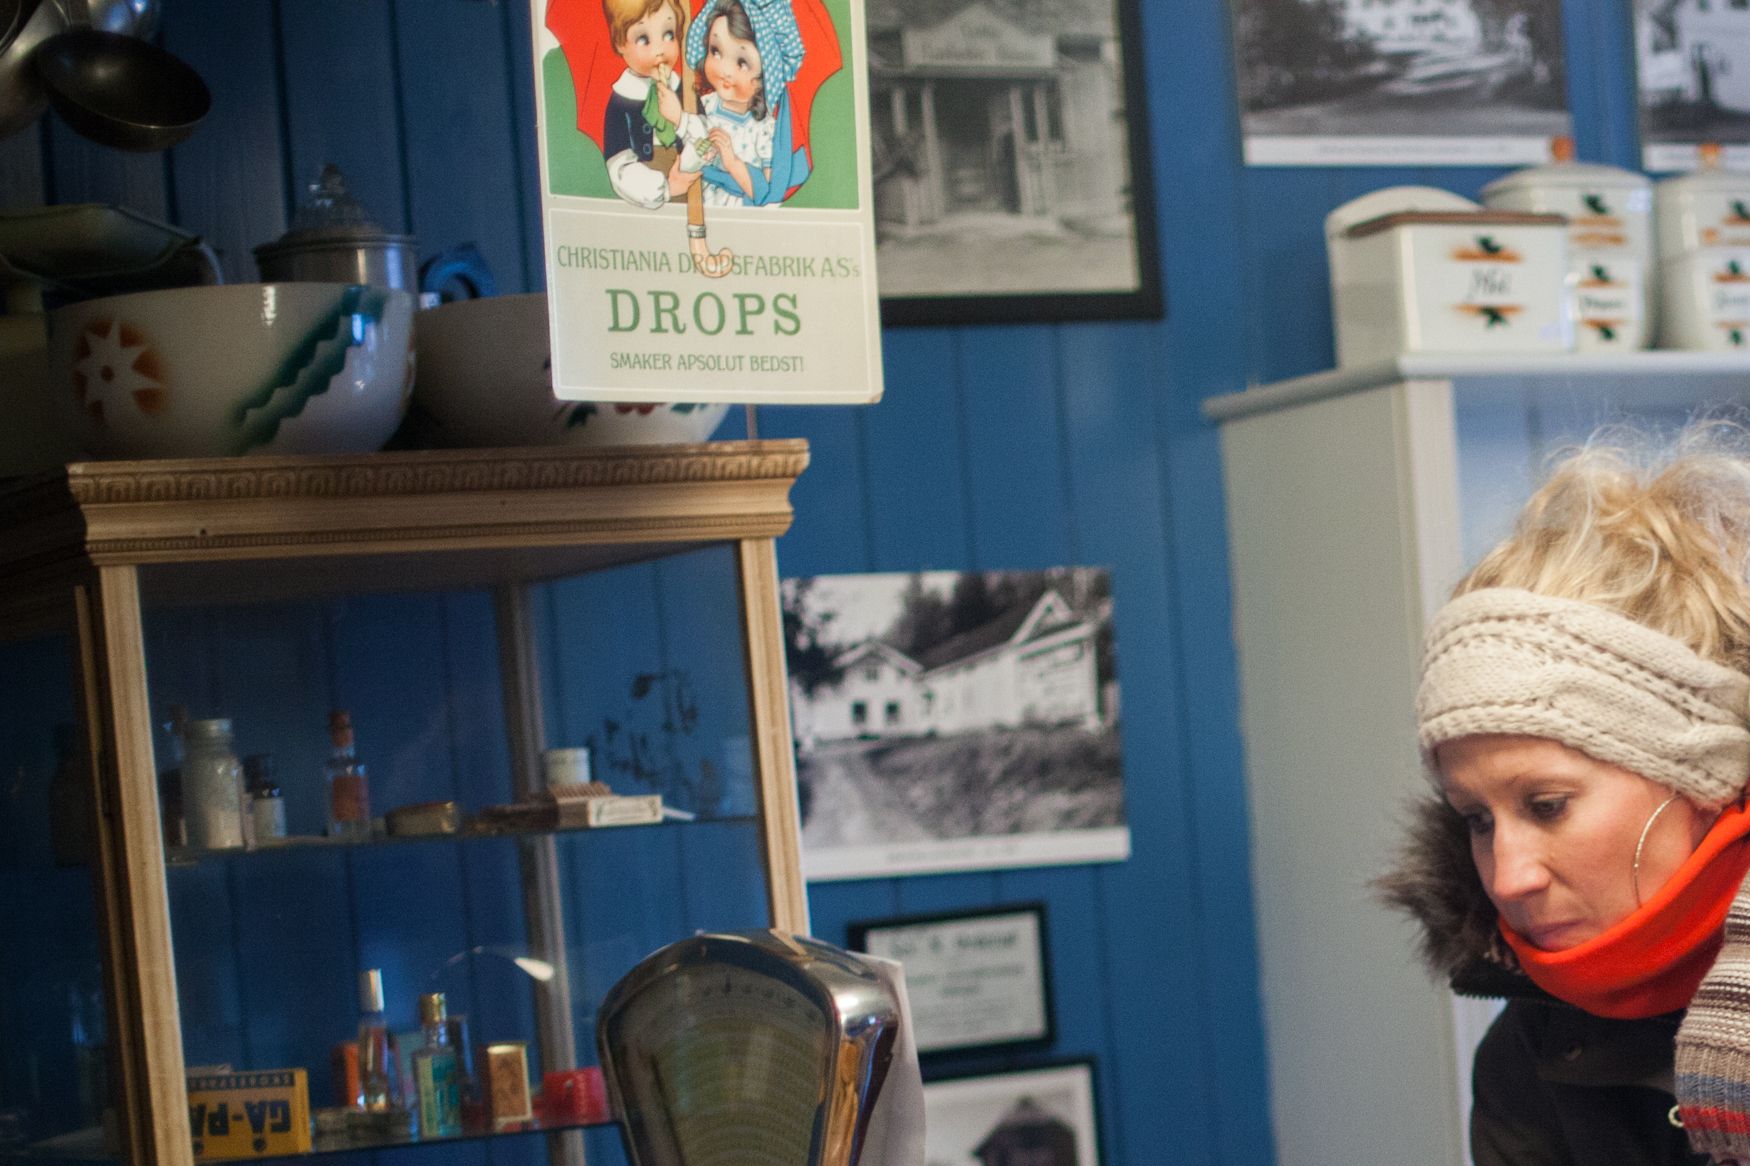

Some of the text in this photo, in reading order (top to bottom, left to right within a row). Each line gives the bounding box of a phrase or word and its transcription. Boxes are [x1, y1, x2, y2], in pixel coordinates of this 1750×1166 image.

[557, 244, 671, 273] CHRISTIANIA
[678, 252, 816, 278] DROPSFABRIK
[605, 288, 801, 336] DROPS
[609, 352, 805, 373] SMAKER APSOLUT BEDST!
